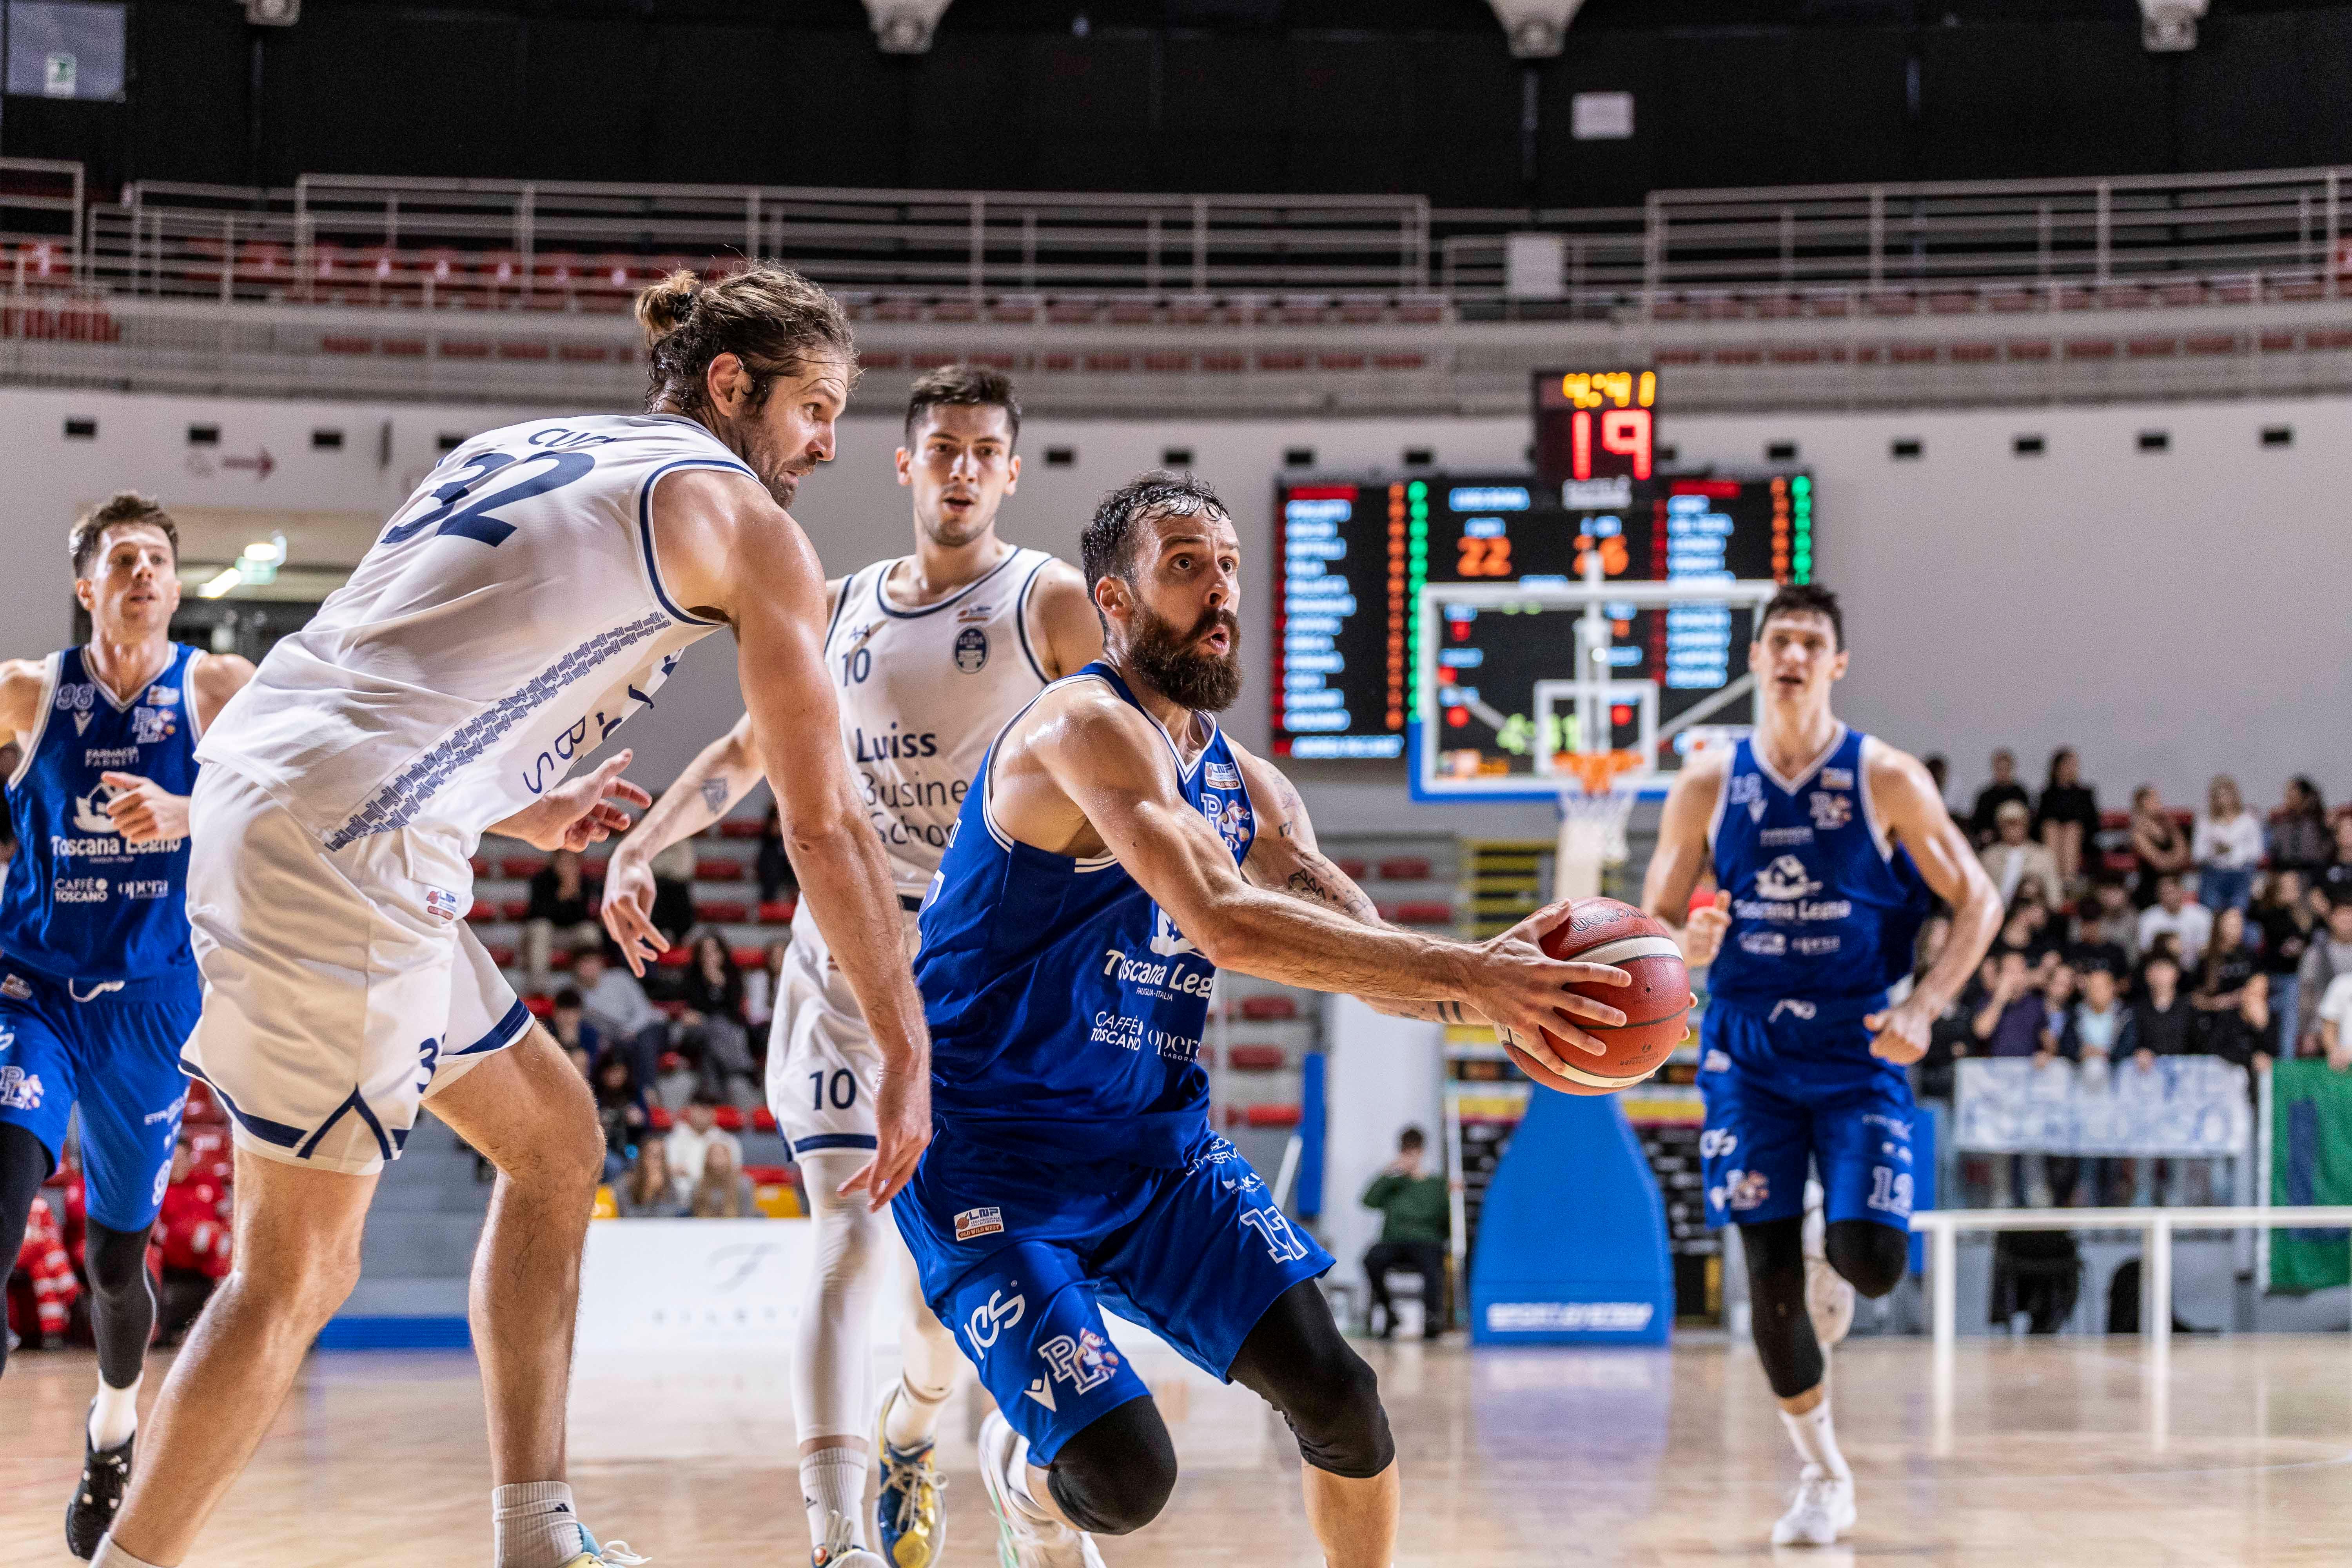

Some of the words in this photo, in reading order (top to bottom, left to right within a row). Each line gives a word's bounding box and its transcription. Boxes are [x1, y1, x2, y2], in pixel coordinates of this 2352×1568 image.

[1572, 409, 1652, 481] 19
[380, 450, 595, 548] 32
[1456, 536, 1512, 577] 22
[842, 648, 871, 687] 10
[856, 722, 937, 762] Luiss
[51, 835, 120, 857] Toscana
[1104, 949, 1167, 985] Toscana
[809, 1068, 856, 1110] 10
[968, 1208, 999, 1221] LNP
[970, 1226, 984, 1235] WILD
[1240, 1205, 1308, 1264] 17
[1038, 1334, 1110, 1396] PL
